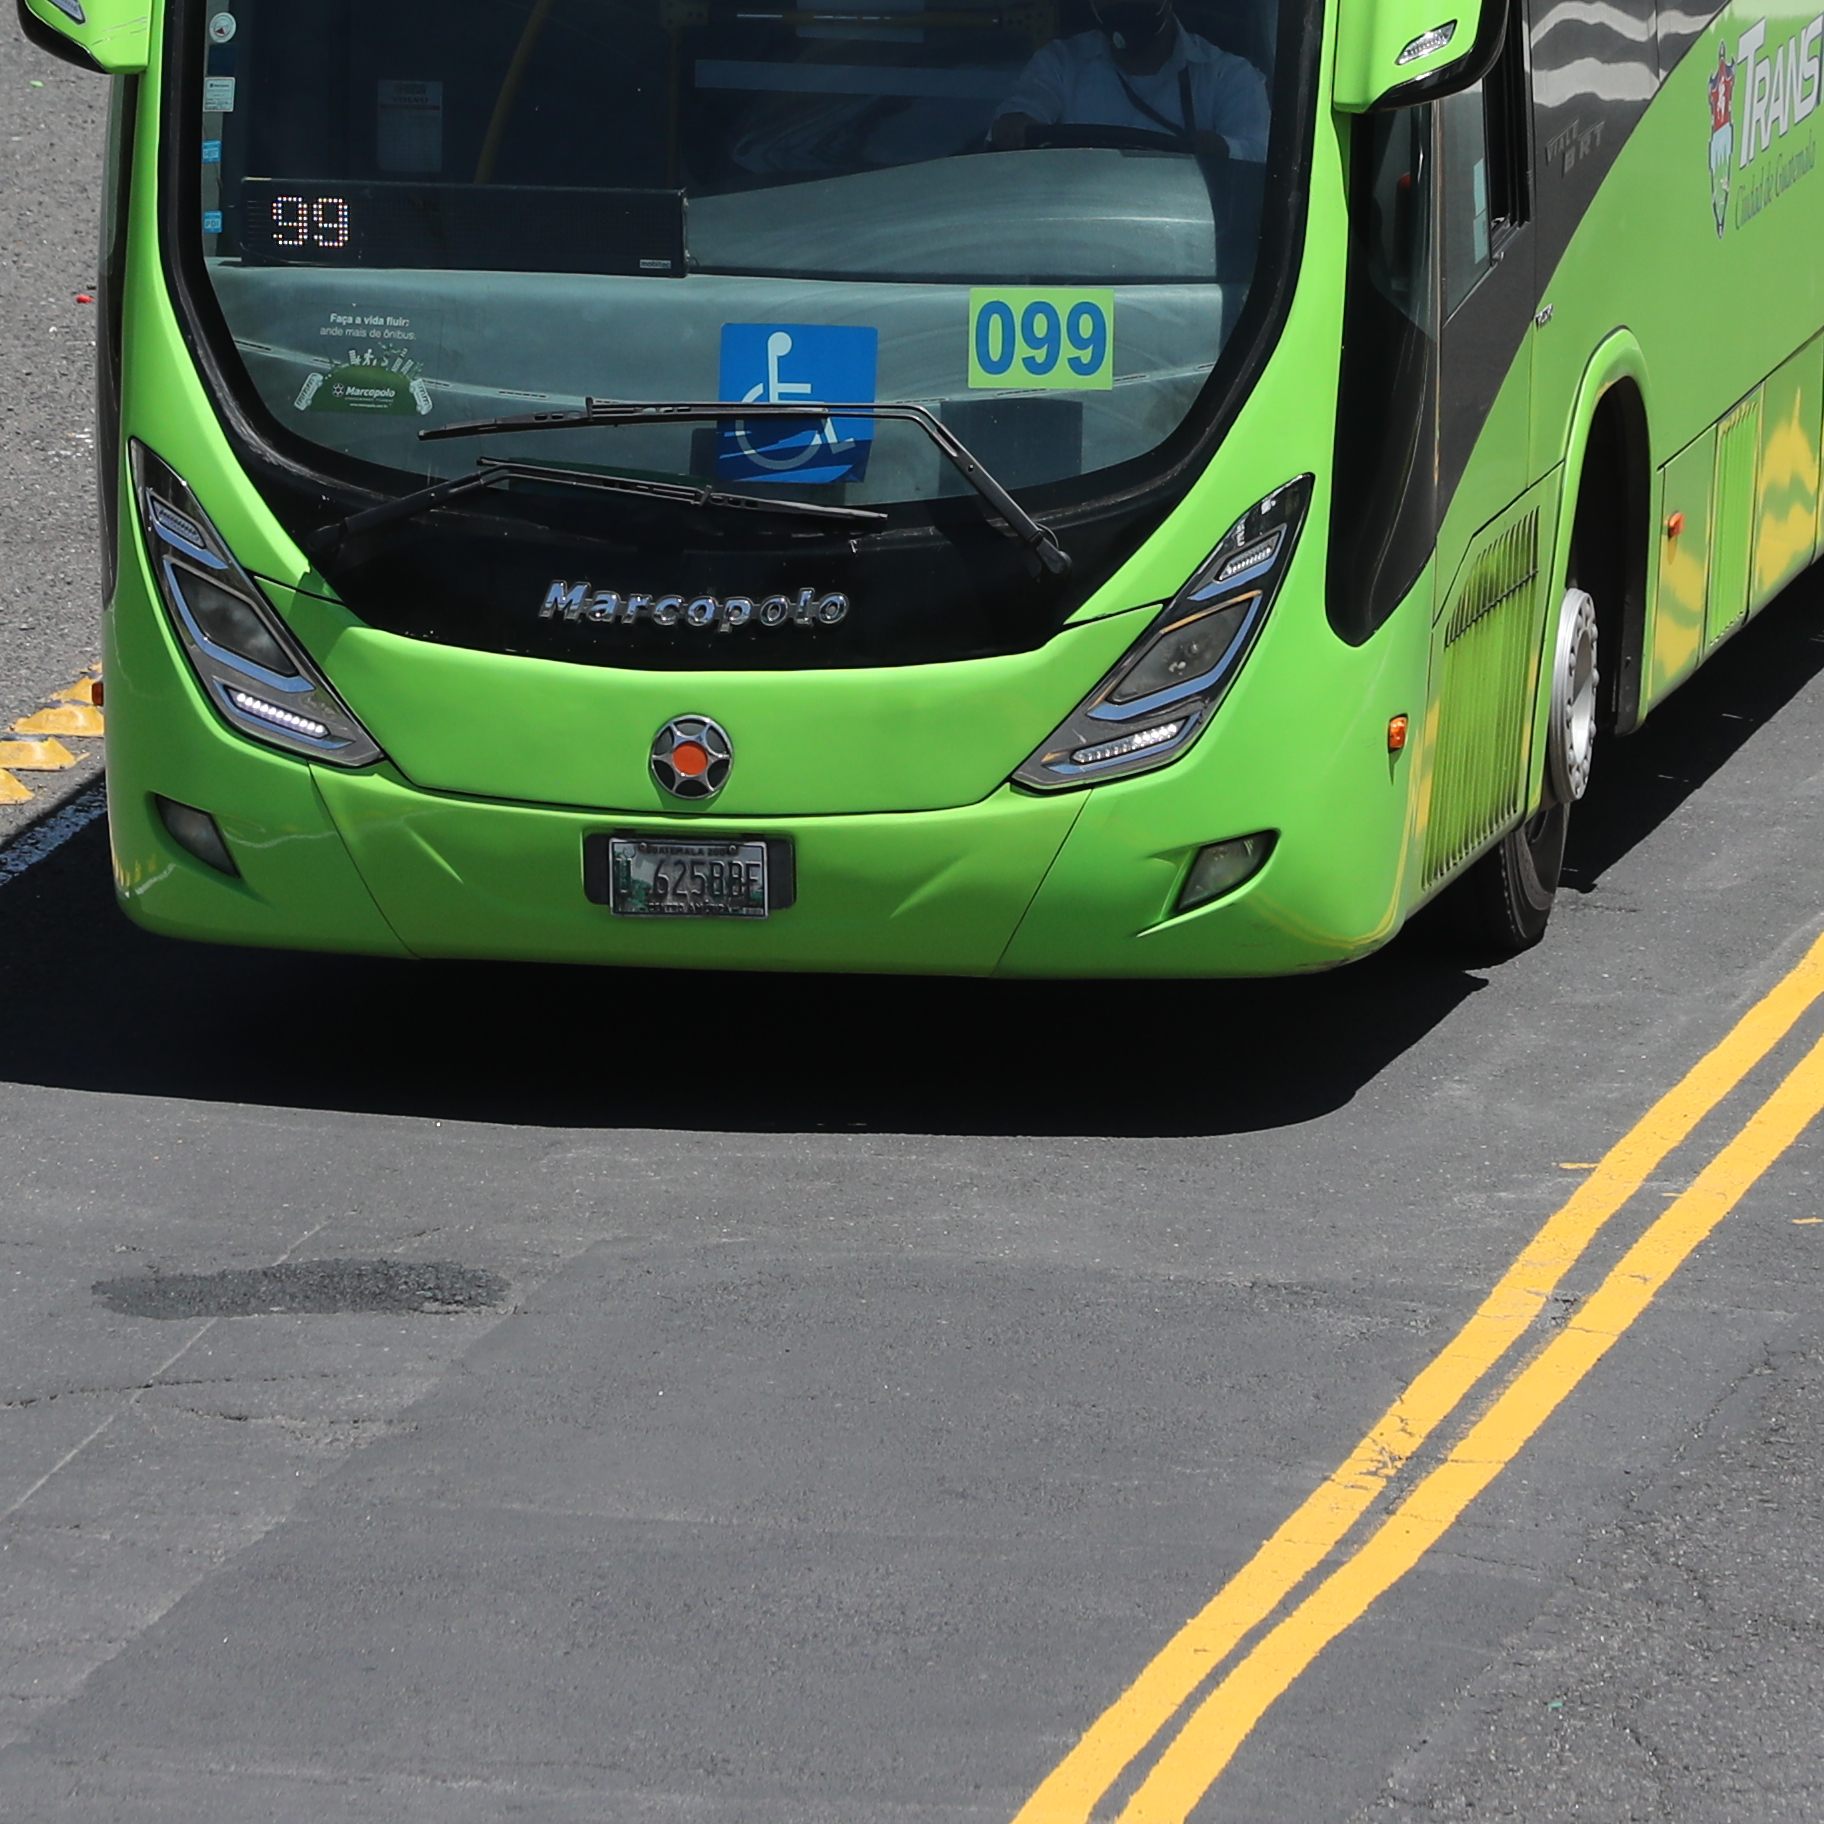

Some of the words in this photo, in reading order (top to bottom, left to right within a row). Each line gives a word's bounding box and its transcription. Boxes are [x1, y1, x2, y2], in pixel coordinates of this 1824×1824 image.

[272, 196, 349, 247] 99
[320, 326, 344, 337] ande
[345, 328, 367, 338] mais
[369, 328, 382, 338] de
[330, 313, 354, 325] Faça
[355, 317, 362, 325] a
[363, 315, 385, 326] vida
[976, 300, 1107, 376] 099
[345, 386, 396, 399] Marcopolo
[538, 580, 850, 633] Marcopolo
[652, 859, 762, 897] 625BBF
